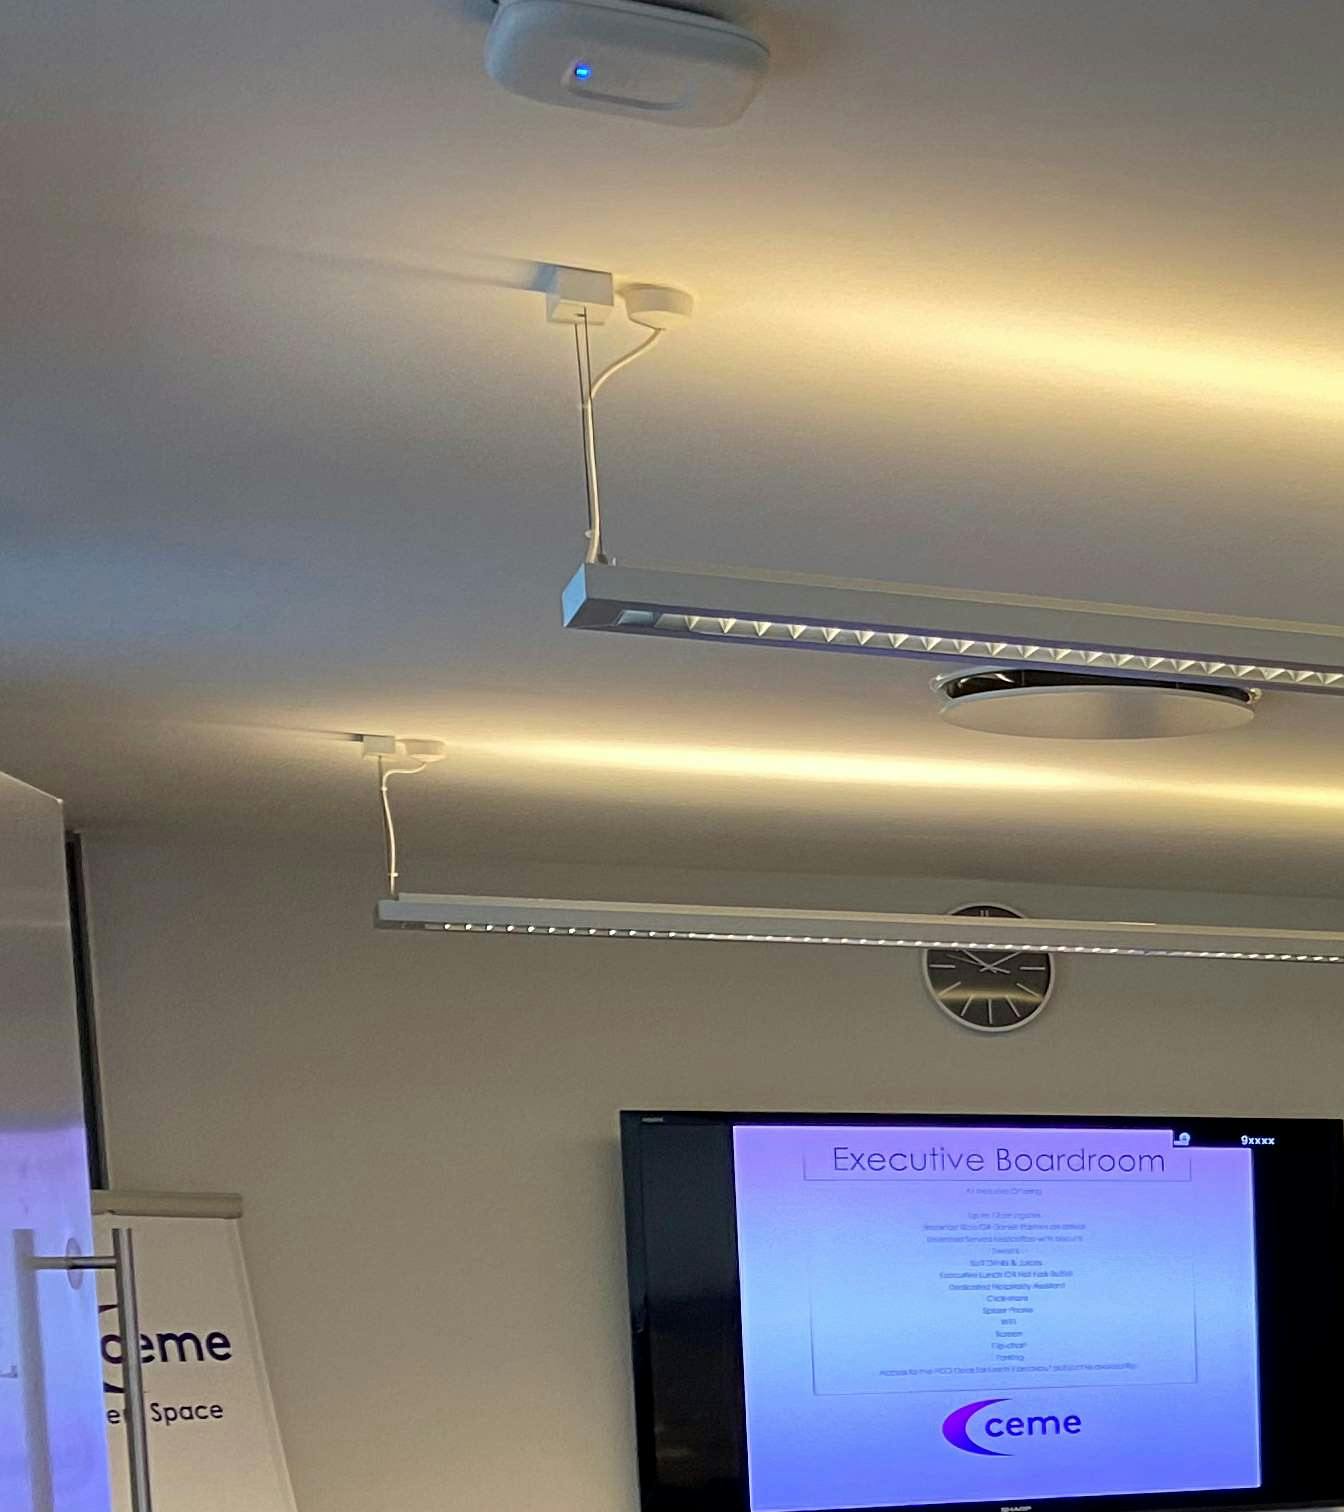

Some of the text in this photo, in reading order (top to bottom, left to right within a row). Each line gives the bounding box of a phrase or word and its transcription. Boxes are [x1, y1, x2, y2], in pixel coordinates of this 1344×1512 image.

[1240, 1134, 1276, 1146] 9xxxx
[833, 1146, 1167, 1173] Executive Boardroom
[101, 1331, 232, 1364] ceme
[150, 1402, 224, 1426] Space
[984, 1413, 1082, 1438] ceme
